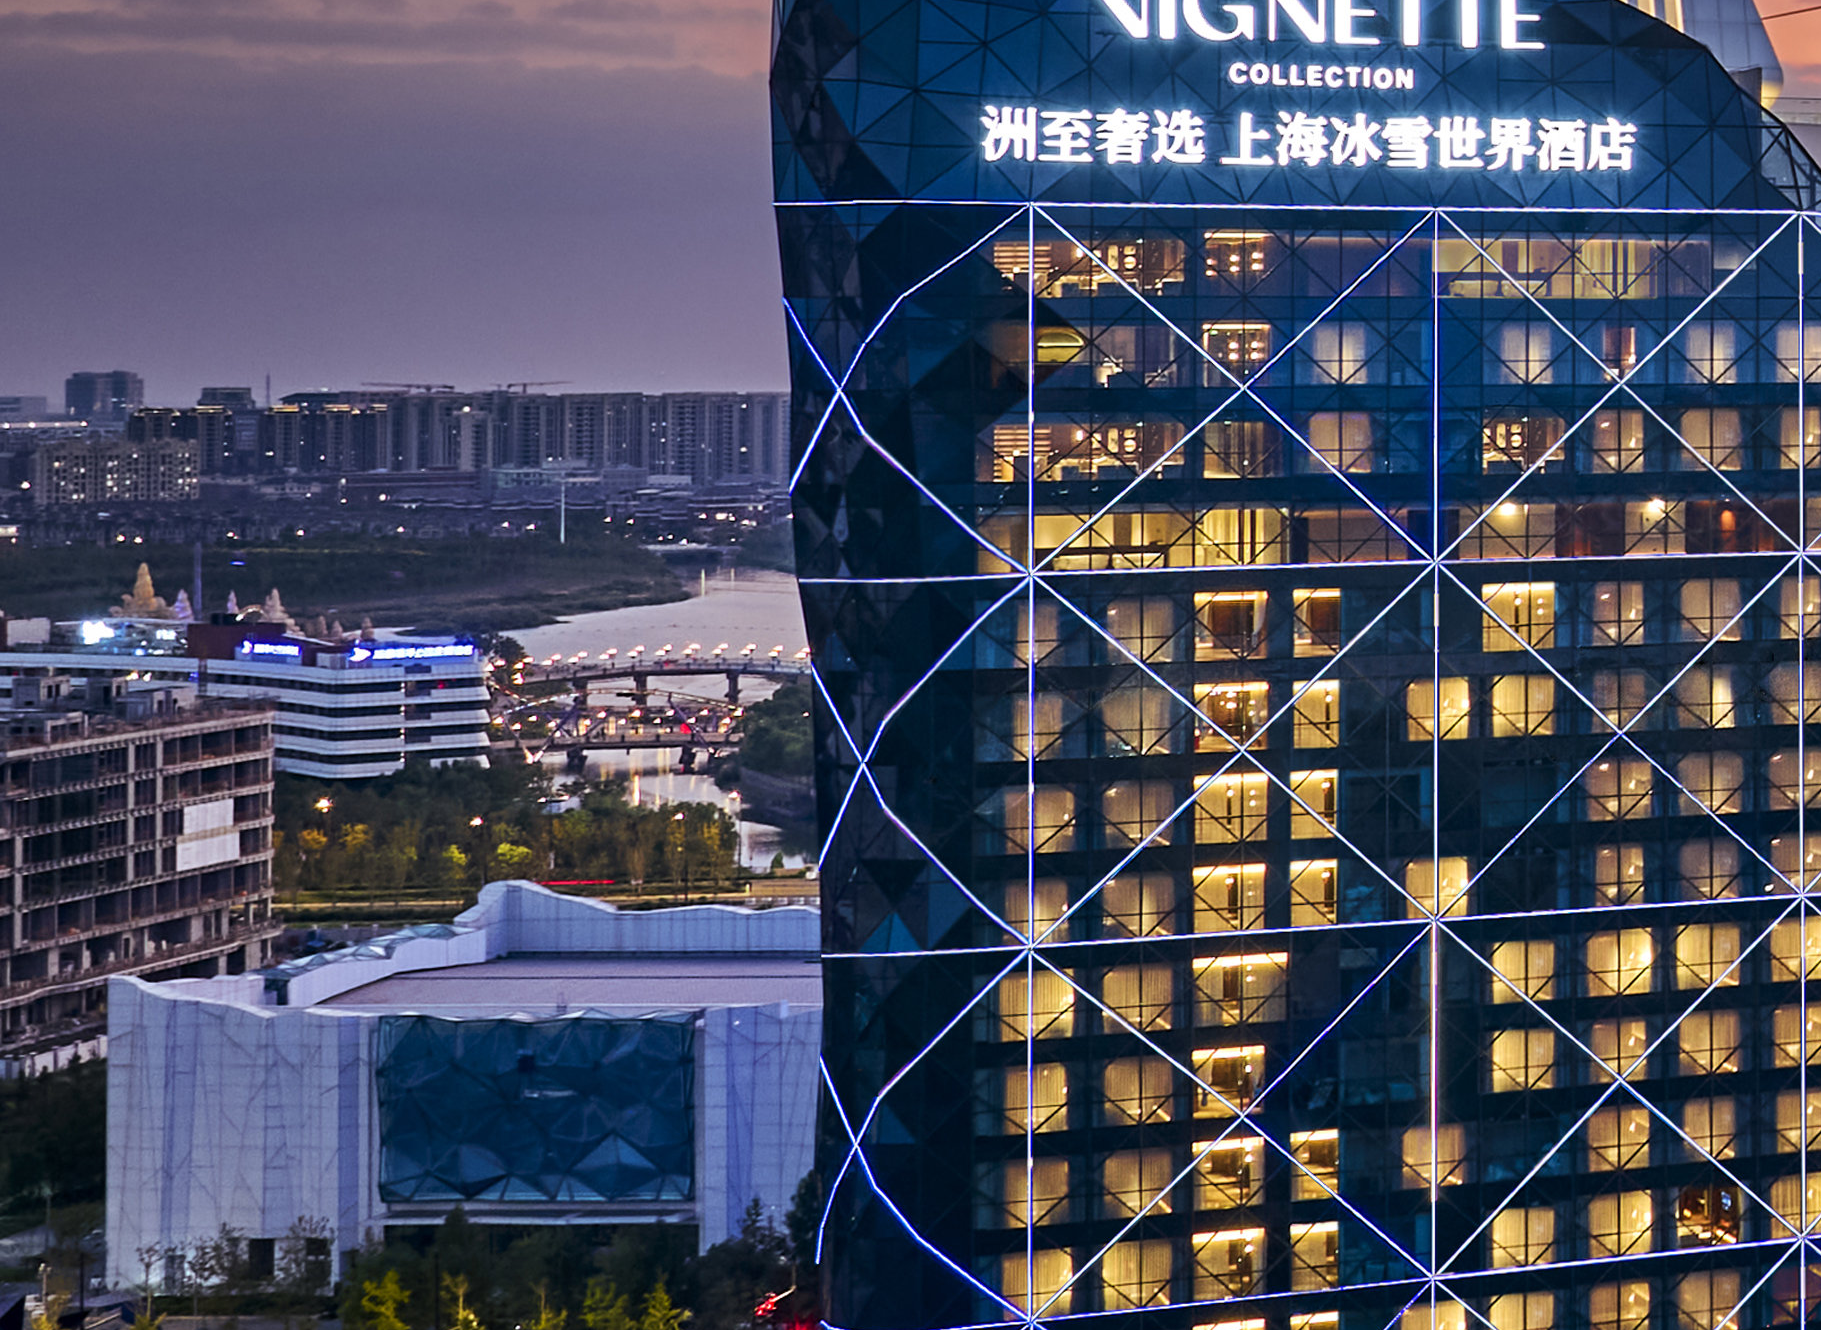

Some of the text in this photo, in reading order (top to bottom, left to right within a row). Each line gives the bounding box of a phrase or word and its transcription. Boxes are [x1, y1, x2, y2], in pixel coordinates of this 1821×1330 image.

[1229, 62, 1414, 90] COLLECTION
[980, 105, 1637, 172] 洲至奢选 上海冰雪世界酒店
